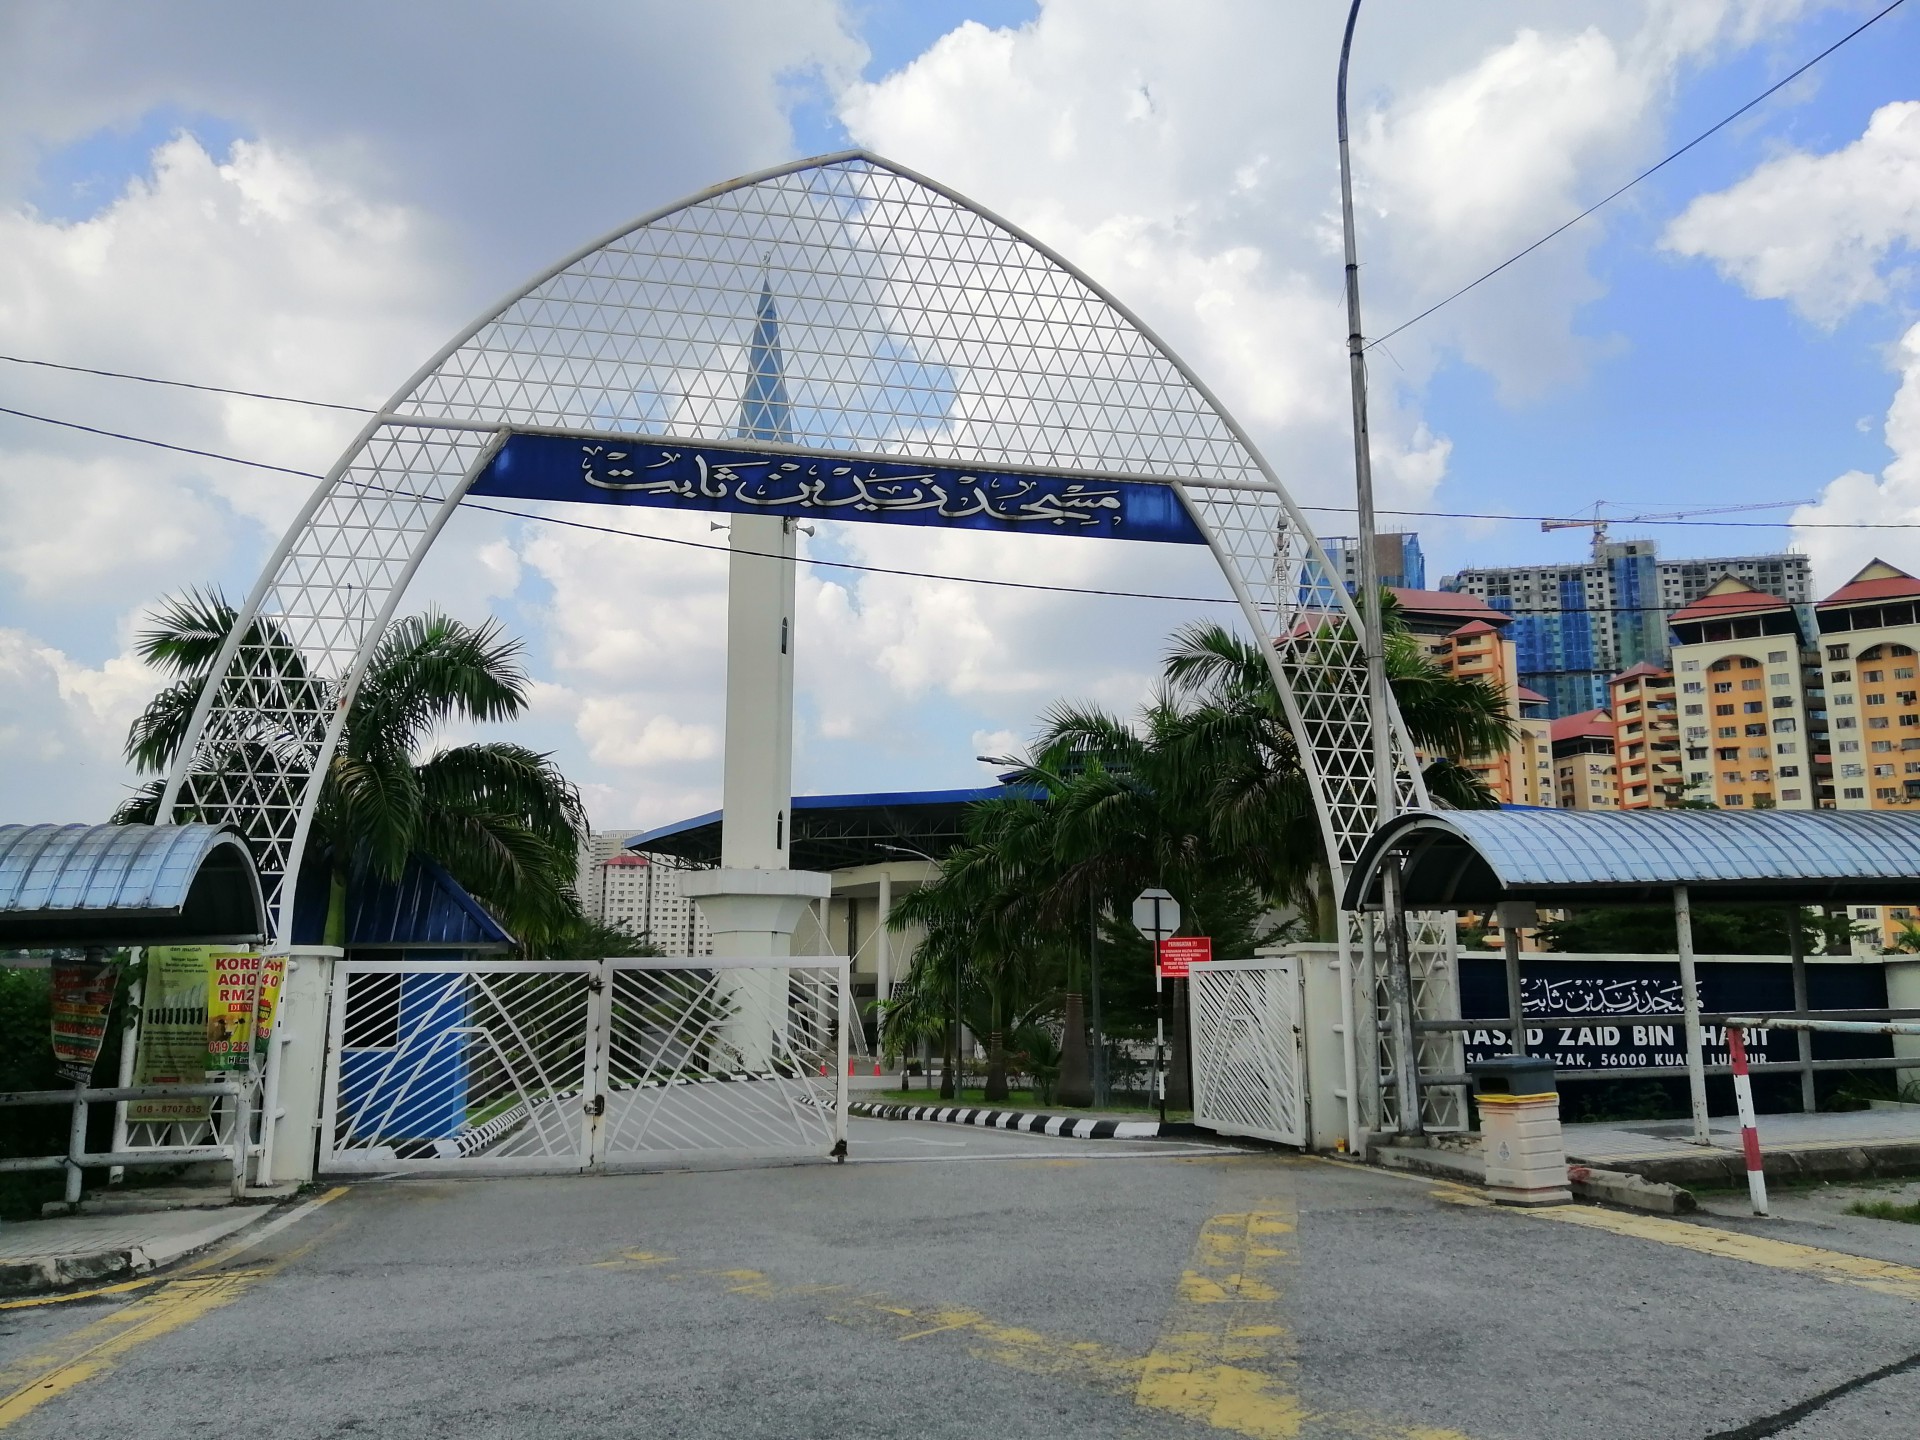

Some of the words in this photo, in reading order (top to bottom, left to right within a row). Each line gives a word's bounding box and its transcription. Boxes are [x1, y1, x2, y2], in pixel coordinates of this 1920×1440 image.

[1558, 1027, 1621, 1046] ZAID
[1633, 1025, 1674, 1046] BIN
[209, 1041, 228, 1053] 019
[1601, 1053, 1647, 1066] 56000
[136, 1105, 152, 1113] 018
[161, 1105, 183, 1113] 8707
[185, 1105, 202, 1113] 835
